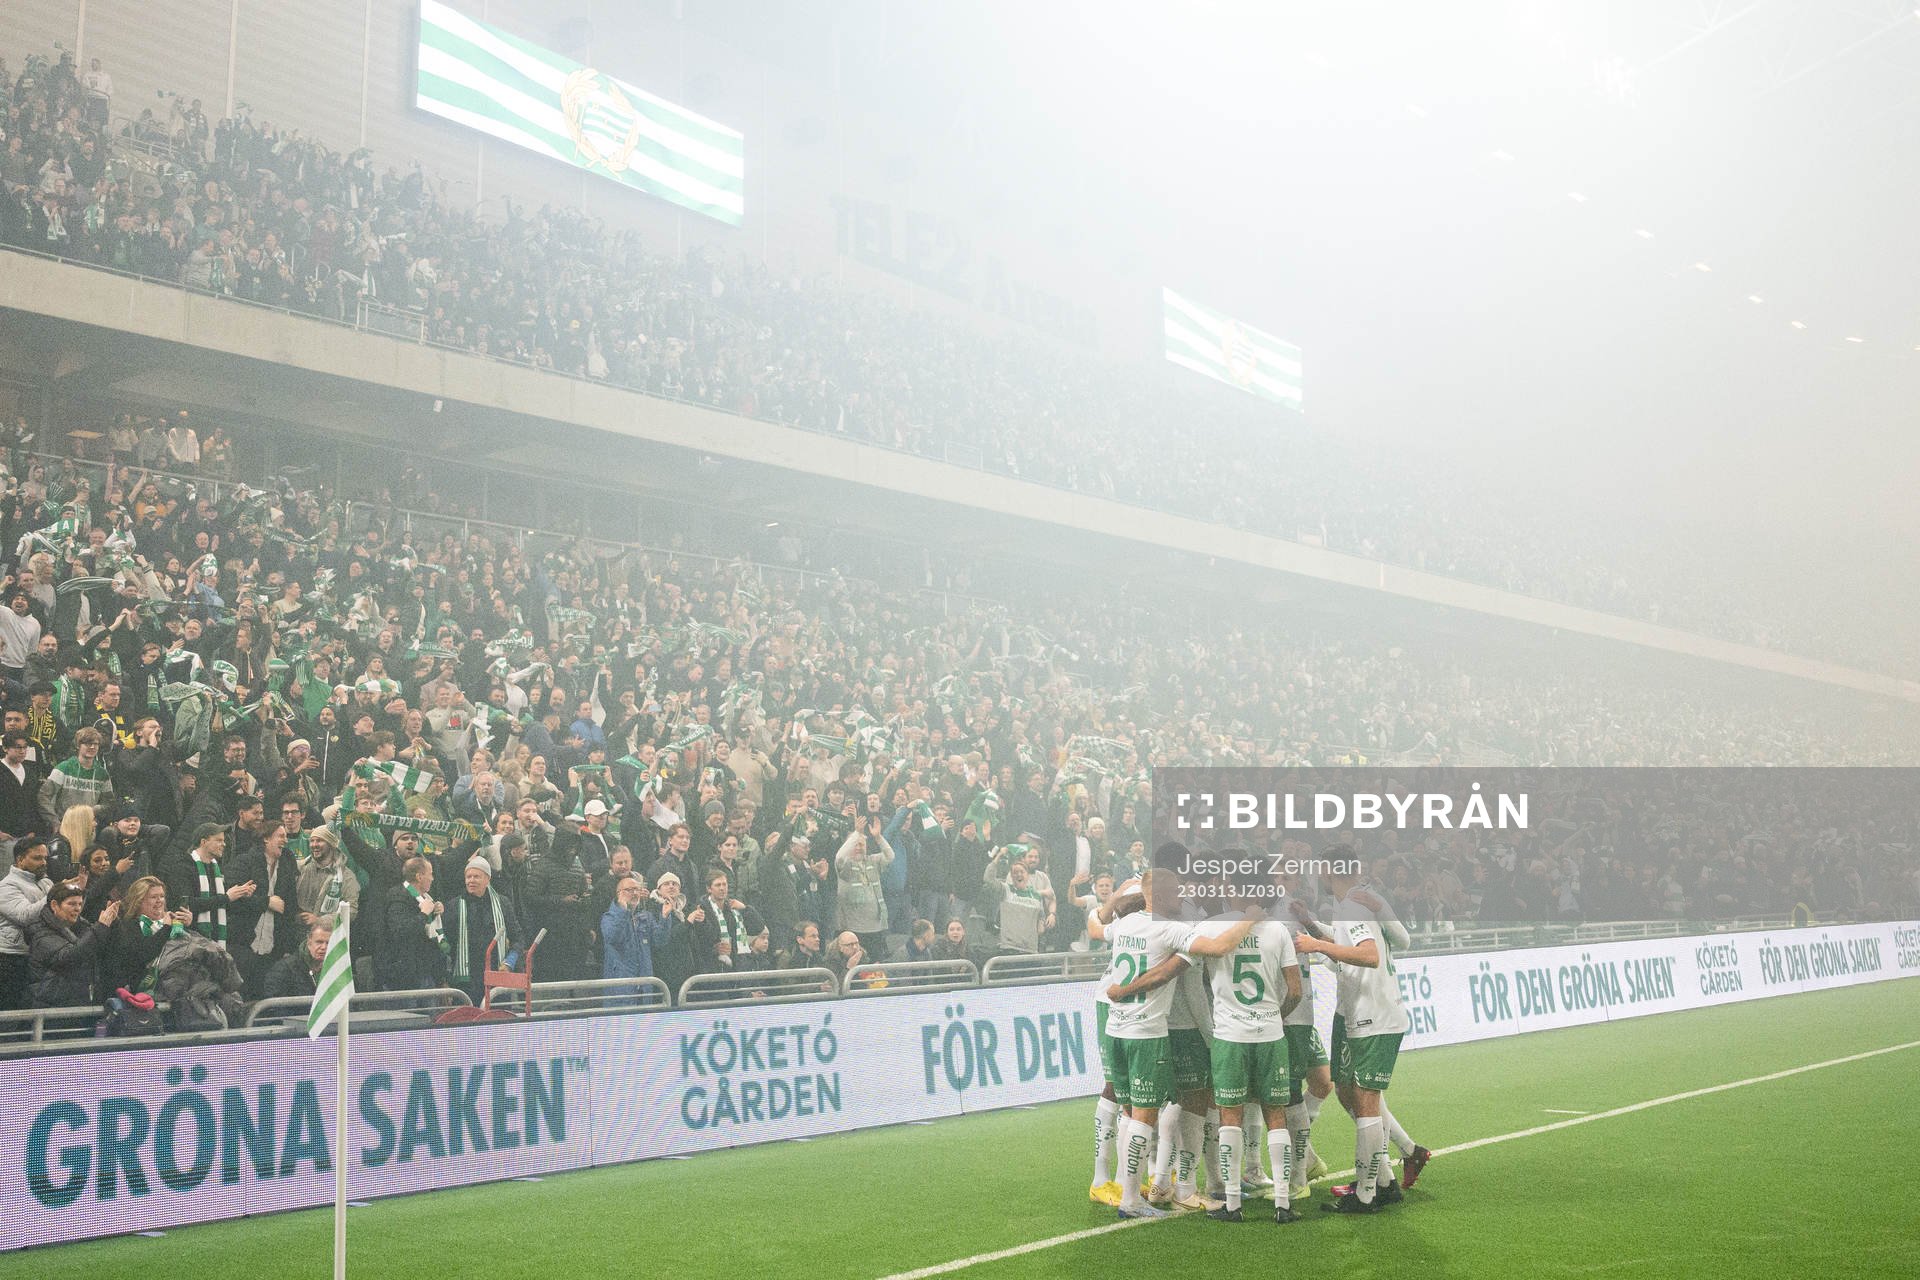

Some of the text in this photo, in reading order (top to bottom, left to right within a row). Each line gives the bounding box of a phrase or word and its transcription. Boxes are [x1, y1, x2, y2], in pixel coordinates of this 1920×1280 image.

[1118, 935, 1147, 950] STRAND
[1758, 937, 1786, 985] FÖR
[1784, 944, 1810, 982] DEN
[1809, 933, 1850, 978] GRÖNA
[1897, 948, 1920, 969] GÅRDE
[1114, 952, 1148, 1004] 21
[1232, 954, 1265, 1006] 5
[1397, 964, 1432, 1003] ETÓ
[1469, 960, 1513, 1024] FÖR
[1515, 967, 1556, 1017] DEN
[1558, 952, 1624, 1012] GRÖNA
[1700, 968, 1743, 996] GÅRDEN
[922, 1003, 1086, 1095] FÖR DEN
[681, 1071, 842, 1131] GÅRDEN
[24, 1065, 333, 1211] GRÖNA
